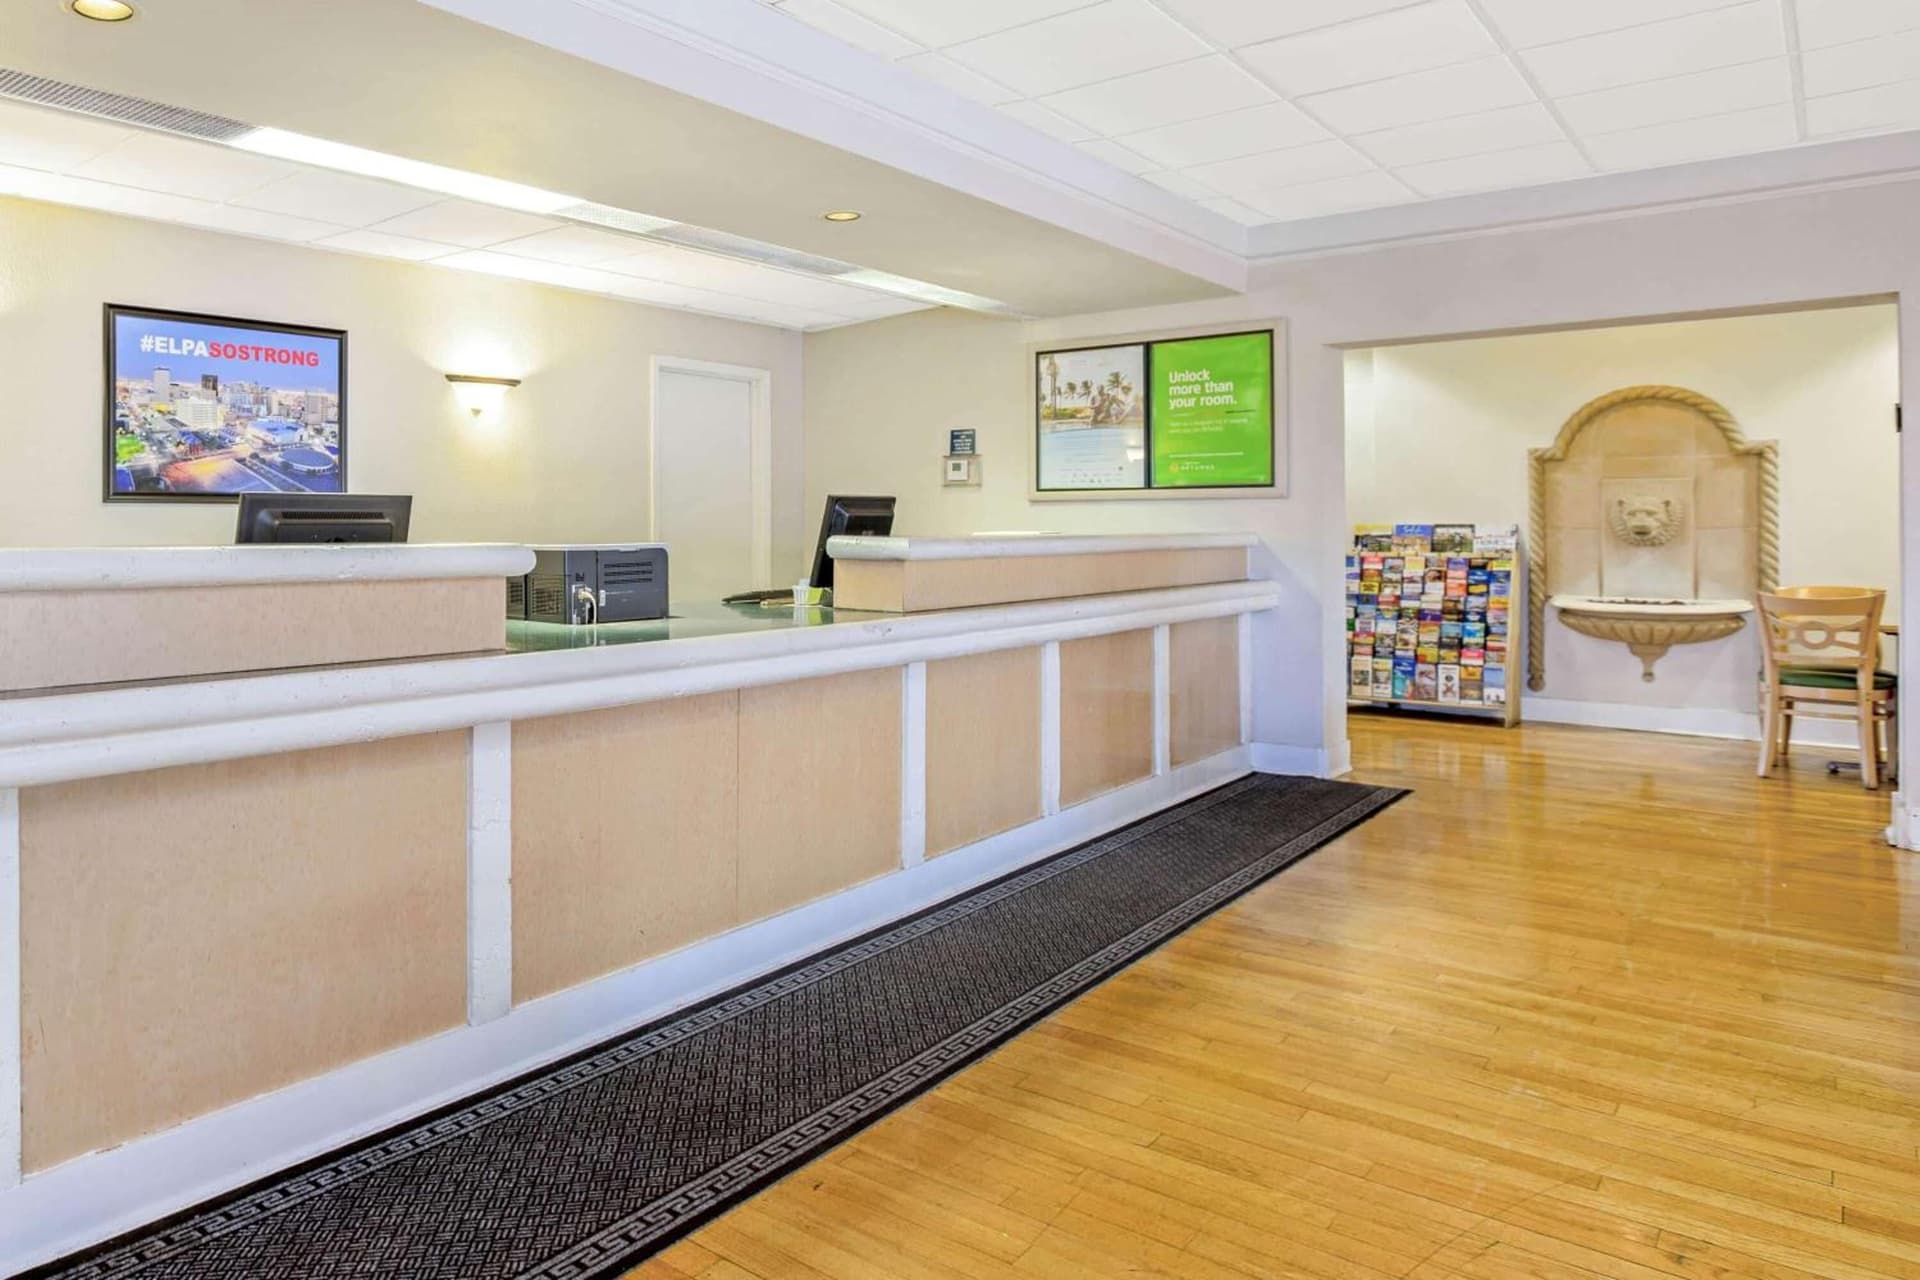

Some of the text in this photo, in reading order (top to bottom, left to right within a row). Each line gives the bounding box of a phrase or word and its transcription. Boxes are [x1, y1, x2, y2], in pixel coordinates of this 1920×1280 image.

[140, 335, 319, 367] #ELPASOSTRONG
[1168, 368, 1210, 383] Unlock
[1169, 381, 1233, 396] more than
[1169, 394, 1237, 410] your room.
